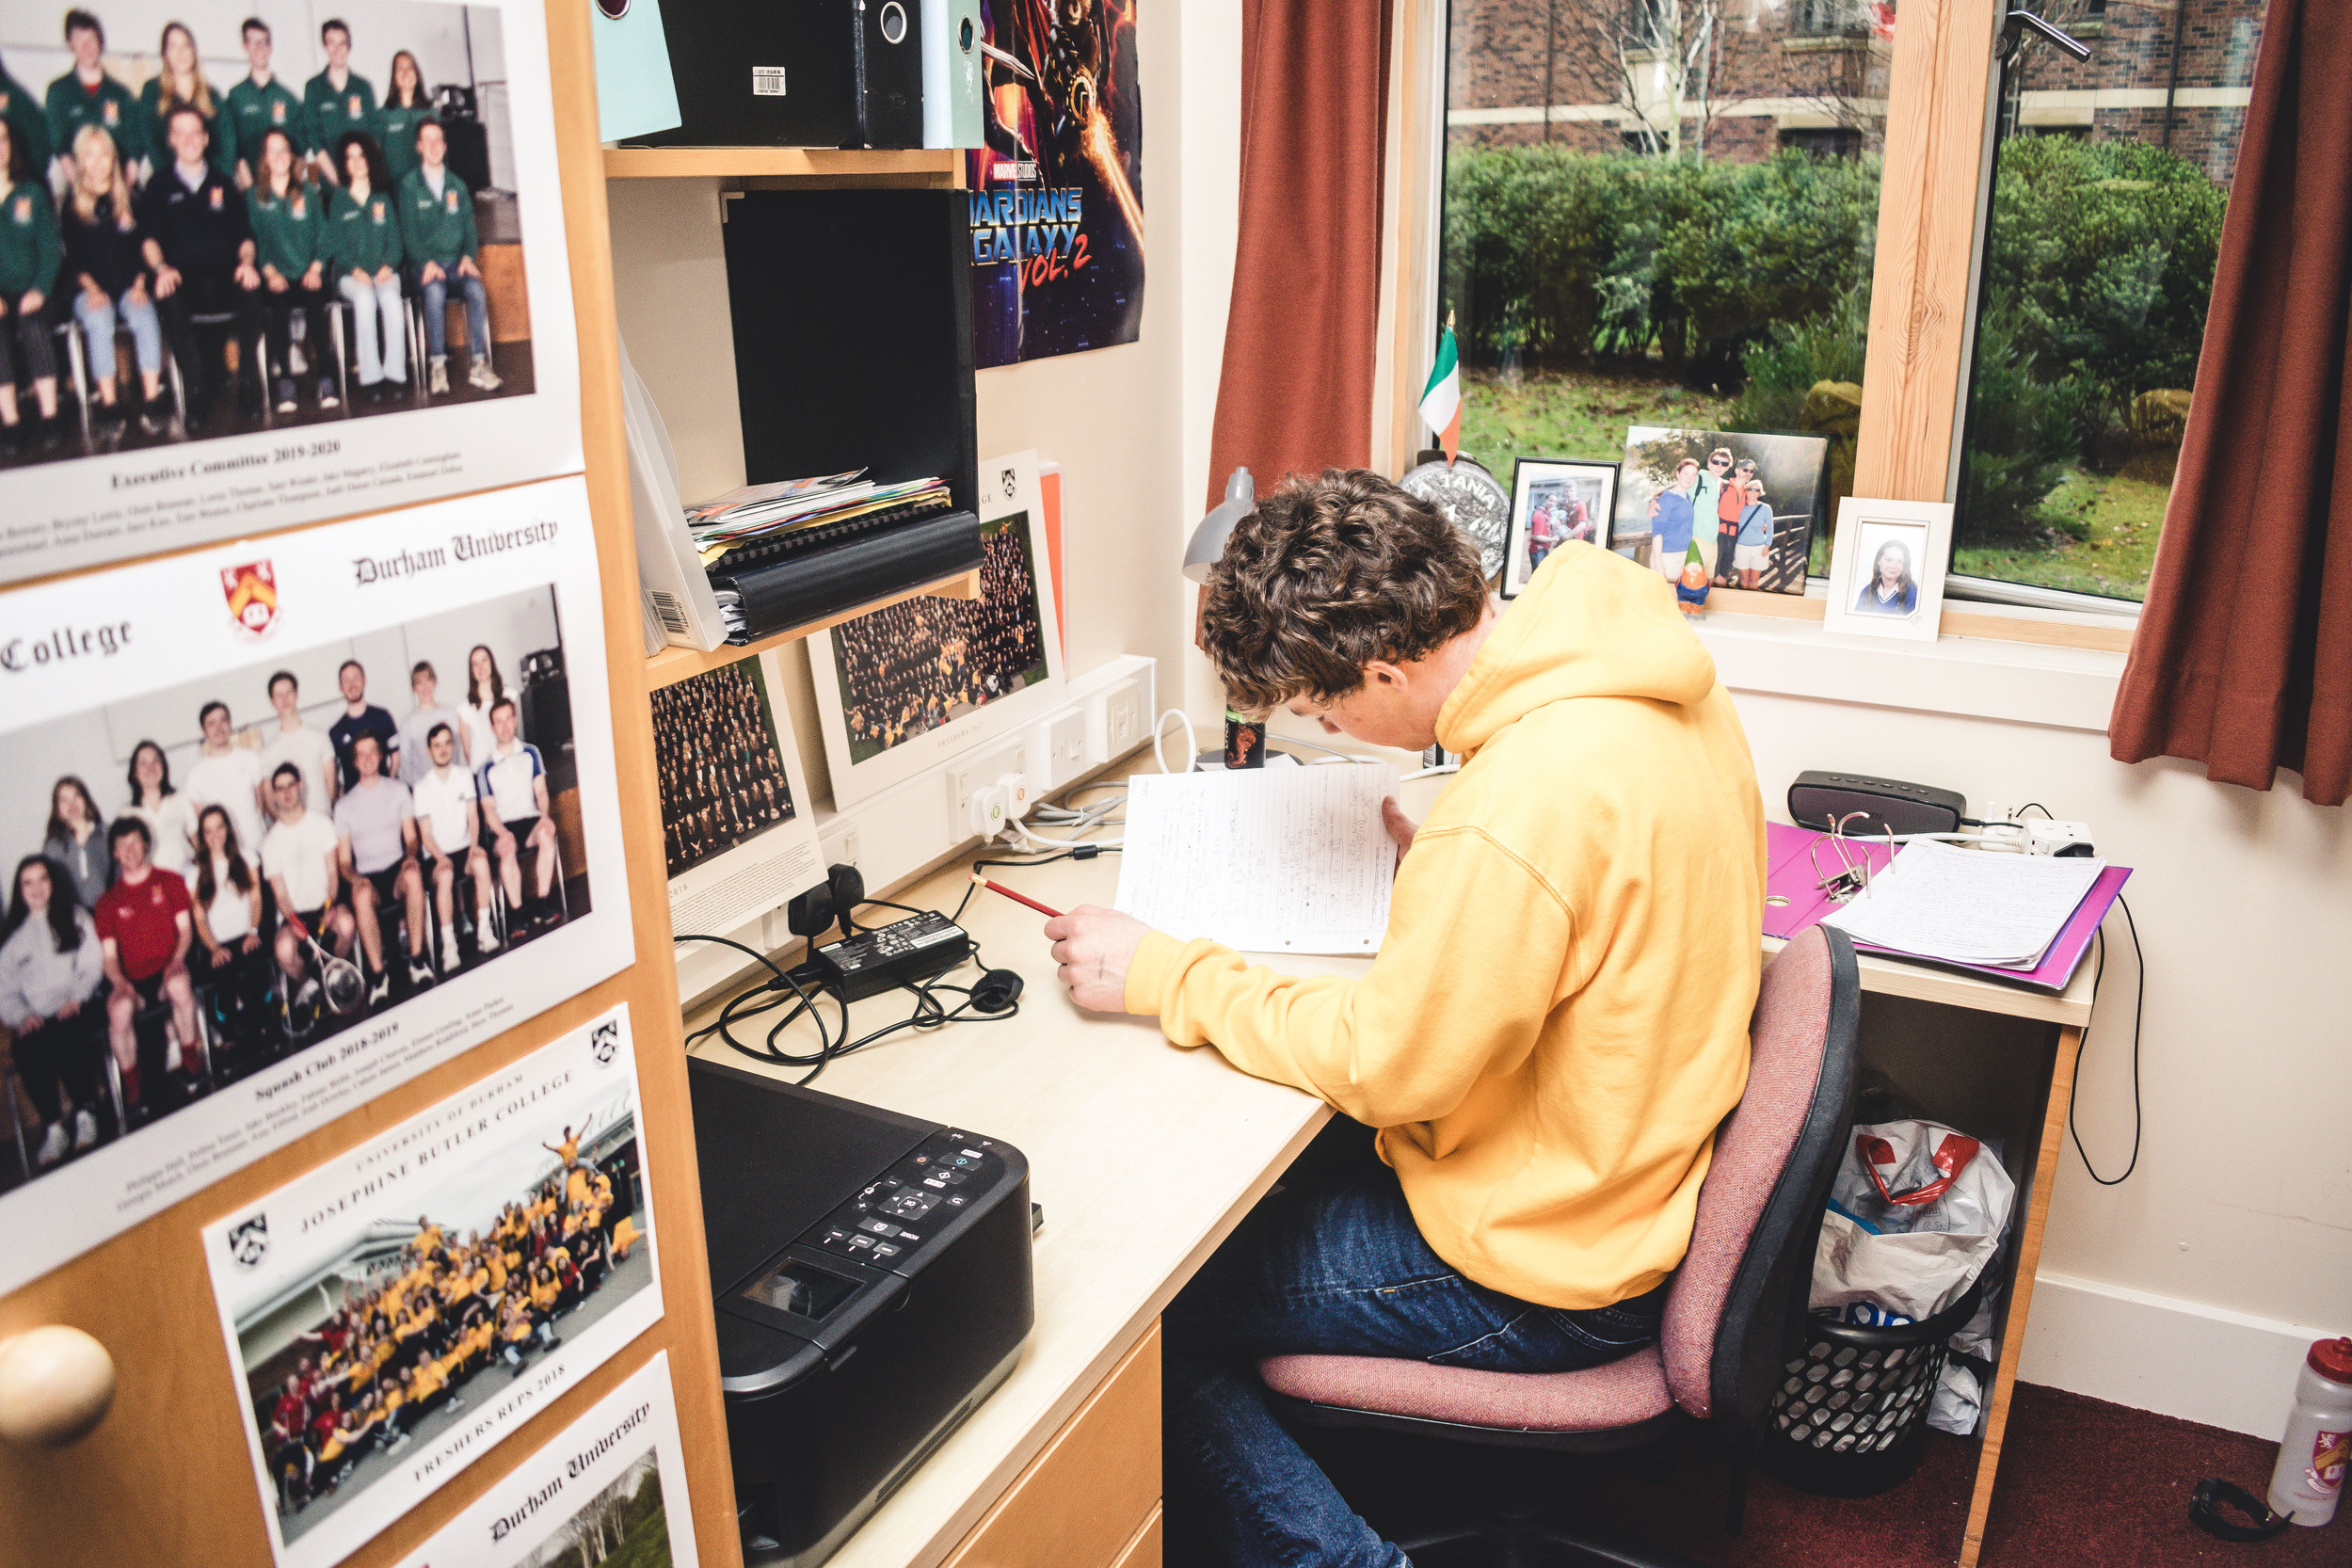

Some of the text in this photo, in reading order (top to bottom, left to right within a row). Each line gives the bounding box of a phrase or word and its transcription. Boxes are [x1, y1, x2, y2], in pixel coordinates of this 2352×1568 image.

[1017, 162, 1037, 179] STUDIOS
[969, 187, 1082, 227] ARDIANS
[1018, 233, 1093, 295] VOL. 2
[111, 440, 341, 489] Executive Committee 2019-2020
[353, 519, 559, 587] Durham University
[0, 620, 131, 672] College
[255, 1071, 303, 1102] Squash
[306, 1053, 337, 1079] Club
[300, 1160, 410, 1234] JOSEPHINE
[418, 1119, 489, 1167] BUTLER
[495, 1069, 574, 1122] COLLEGE
[354, 1117, 443, 1175] UNIVERSITY
[448, 1105, 465, 1122] OF
[900, 1230, 920, 1241] HOME
[414, 1363, 566, 1483] FRESHERS REPS 2018
[489, 1400, 651, 1544] Durham University
